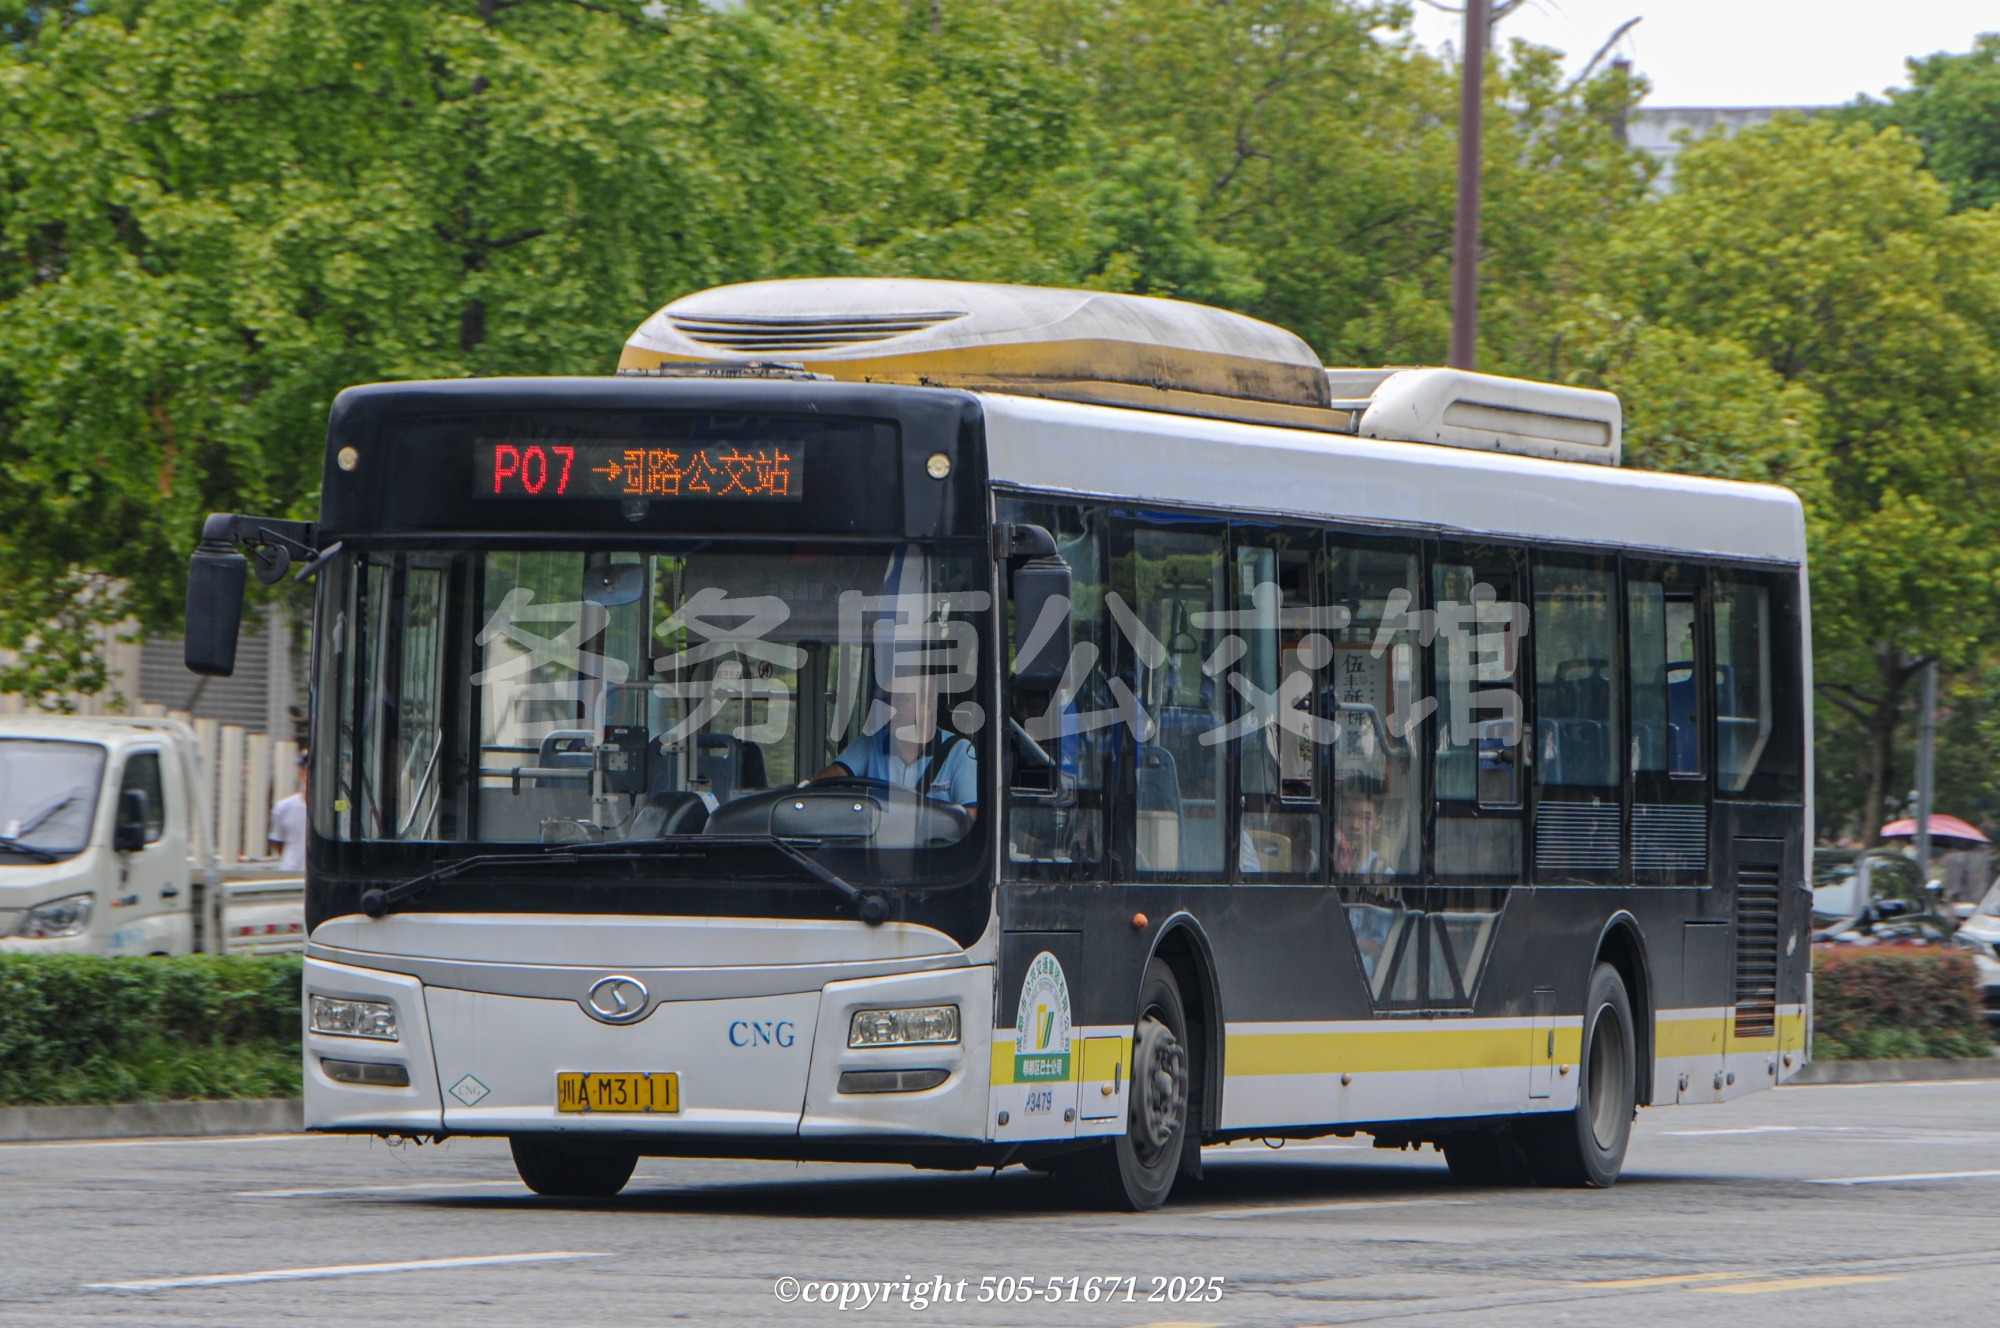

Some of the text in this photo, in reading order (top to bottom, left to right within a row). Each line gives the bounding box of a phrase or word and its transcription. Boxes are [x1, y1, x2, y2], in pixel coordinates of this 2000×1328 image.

[494, 445, 574, 494] P07
[728, 1020, 795, 1048] CNG
[458, 1085, 481, 1097] CNG
